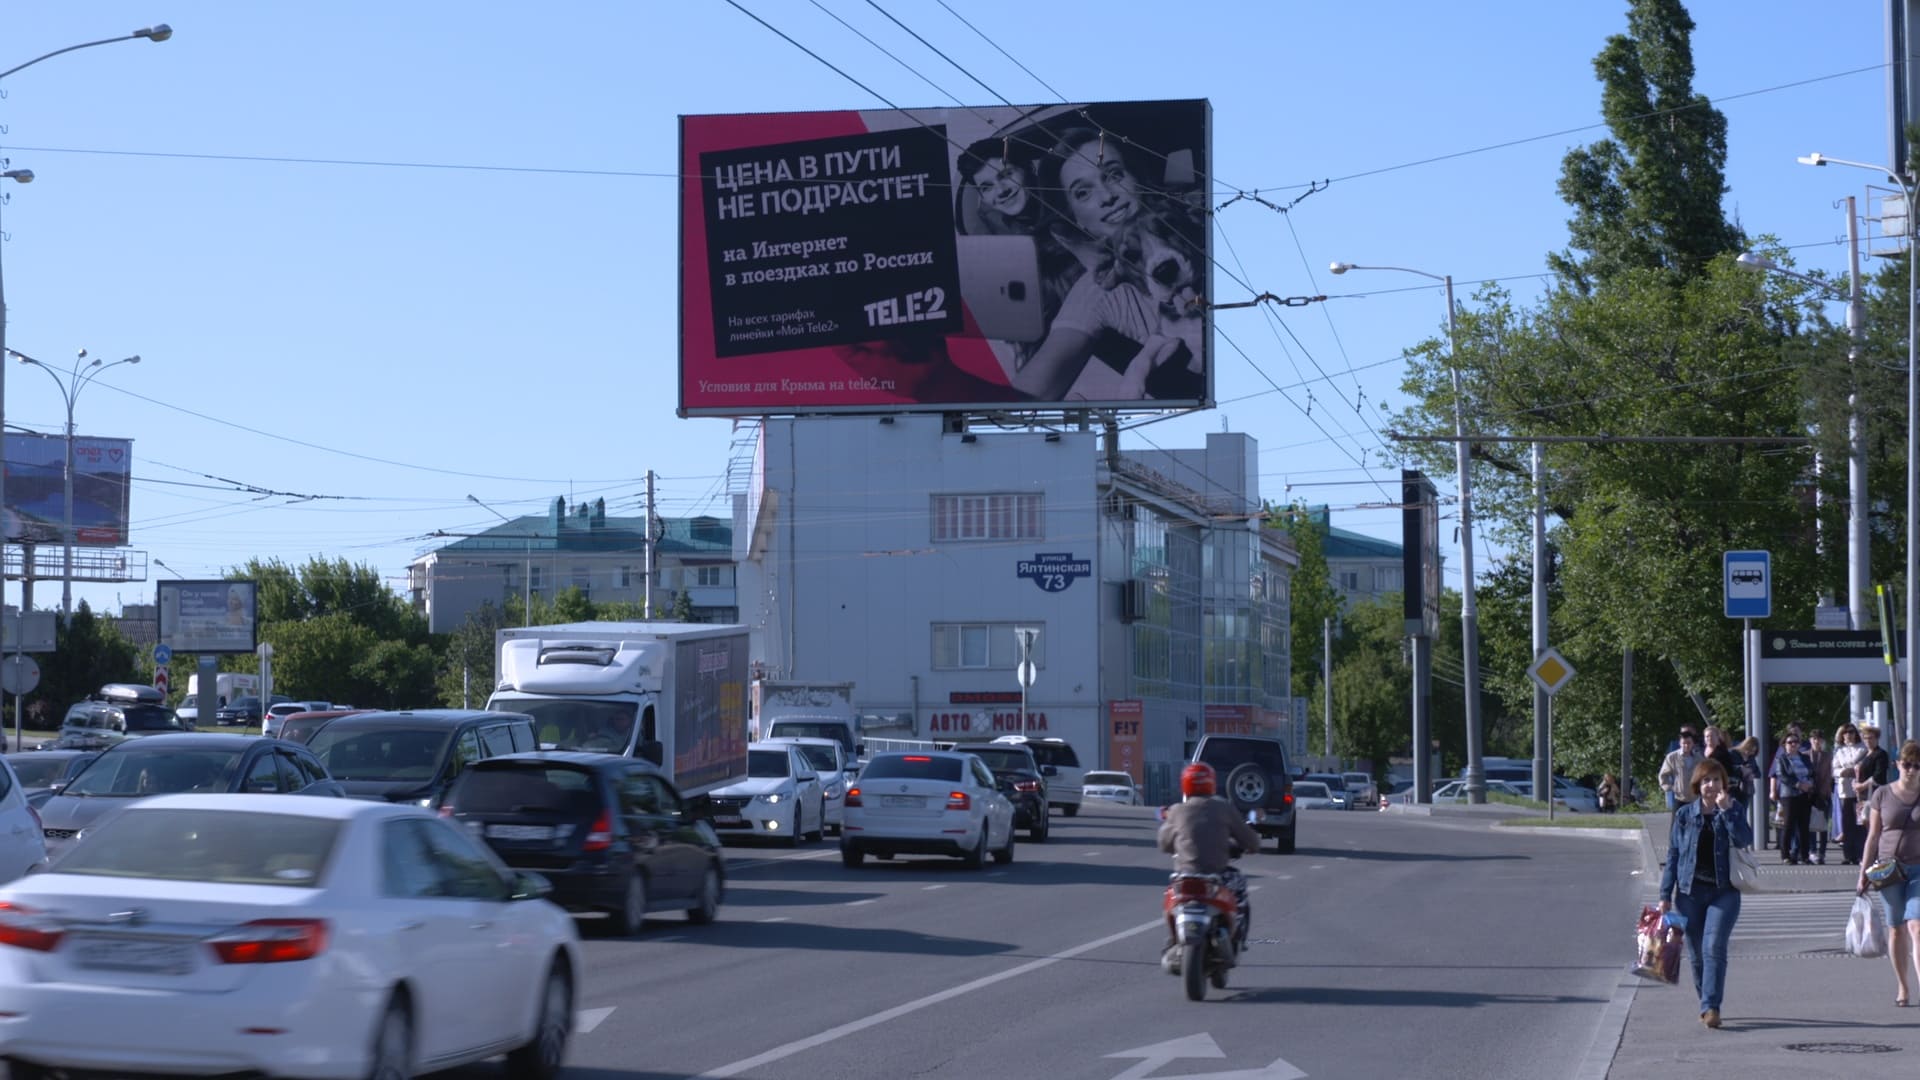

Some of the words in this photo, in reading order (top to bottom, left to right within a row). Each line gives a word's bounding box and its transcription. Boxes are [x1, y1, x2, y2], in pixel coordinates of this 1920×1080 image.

[715, 158, 793, 192] ЦЕНА
[799, 155, 819, 179] В
[824, 145, 901, 176] ПУТИ
[717, 193, 755, 220] НЕ
[761, 173, 929, 215] ПОДРАСТЕТ
[723, 248, 747, 262] на
[751, 236, 848, 259] Интернет
[725, 273, 736, 286] в
[742, 261, 830, 284] поездках
[834, 258, 858, 275] по
[863, 250, 933, 271] России
[728, 316, 743, 328] На
[745, 314, 769, 326] всех
[771, 309, 816, 327] тарифах
[863, 286, 947, 327] TELE2
[729, 328, 774, 343] линейки
[775, 322, 804, 338] «Мой
[807, 319, 839, 334] Tele2»
[698, 380, 751, 393] Условия
[754, 382, 777, 393] для
[781, 379, 825, 394] Крыма
[829, 381, 844, 391] на
[848, 377, 896, 391] tele2.ru
[1019, 562, 1089, 573] Ялтинская
[1041, 555, 1067, 563] улица
[1042, 574, 1065, 589] 73
[930, 713, 971, 731] АВТО
[992, 706, 1048, 731] МОЙКА
